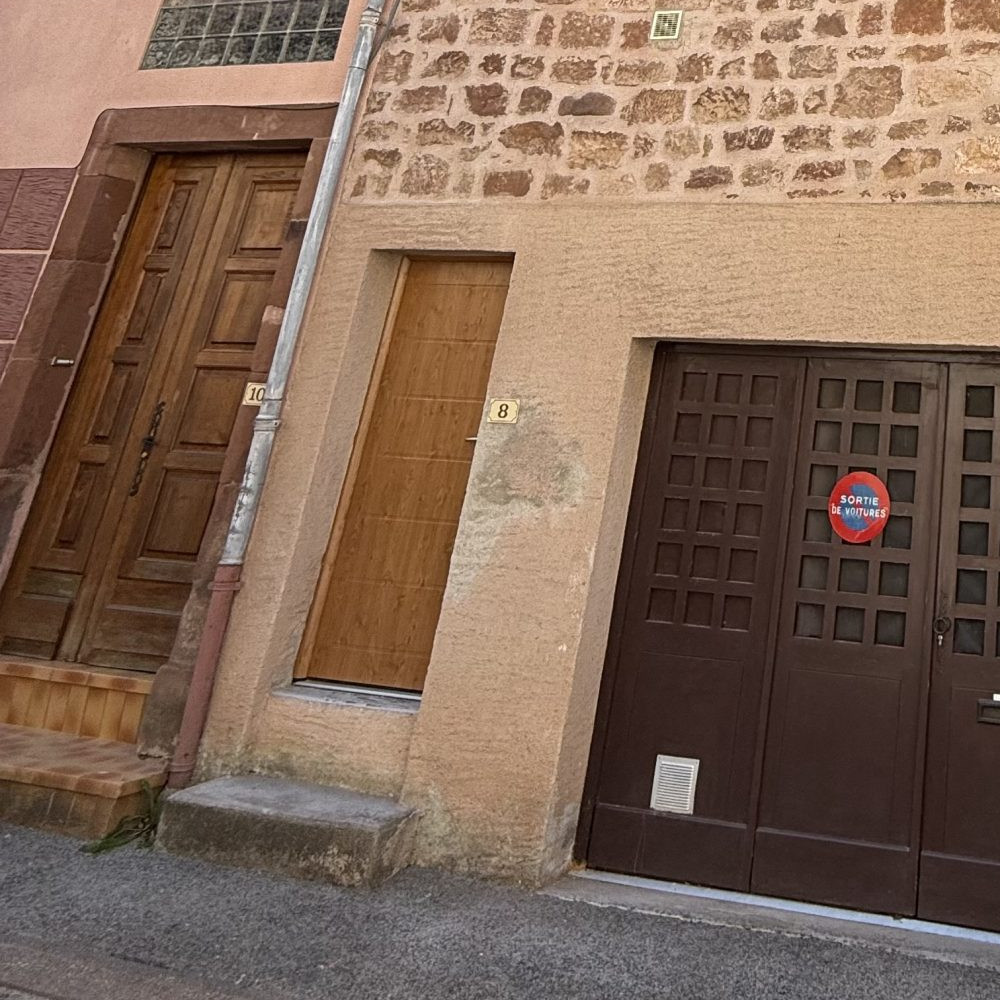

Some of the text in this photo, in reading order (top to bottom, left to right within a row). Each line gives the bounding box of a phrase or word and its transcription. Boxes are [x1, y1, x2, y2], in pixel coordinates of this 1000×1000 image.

[248, 387, 266, 401] 10
[498, 403, 509, 418] 8
[840, 494, 879, 506] SORTIE
[831, 506, 886, 518] DE VOITURES
